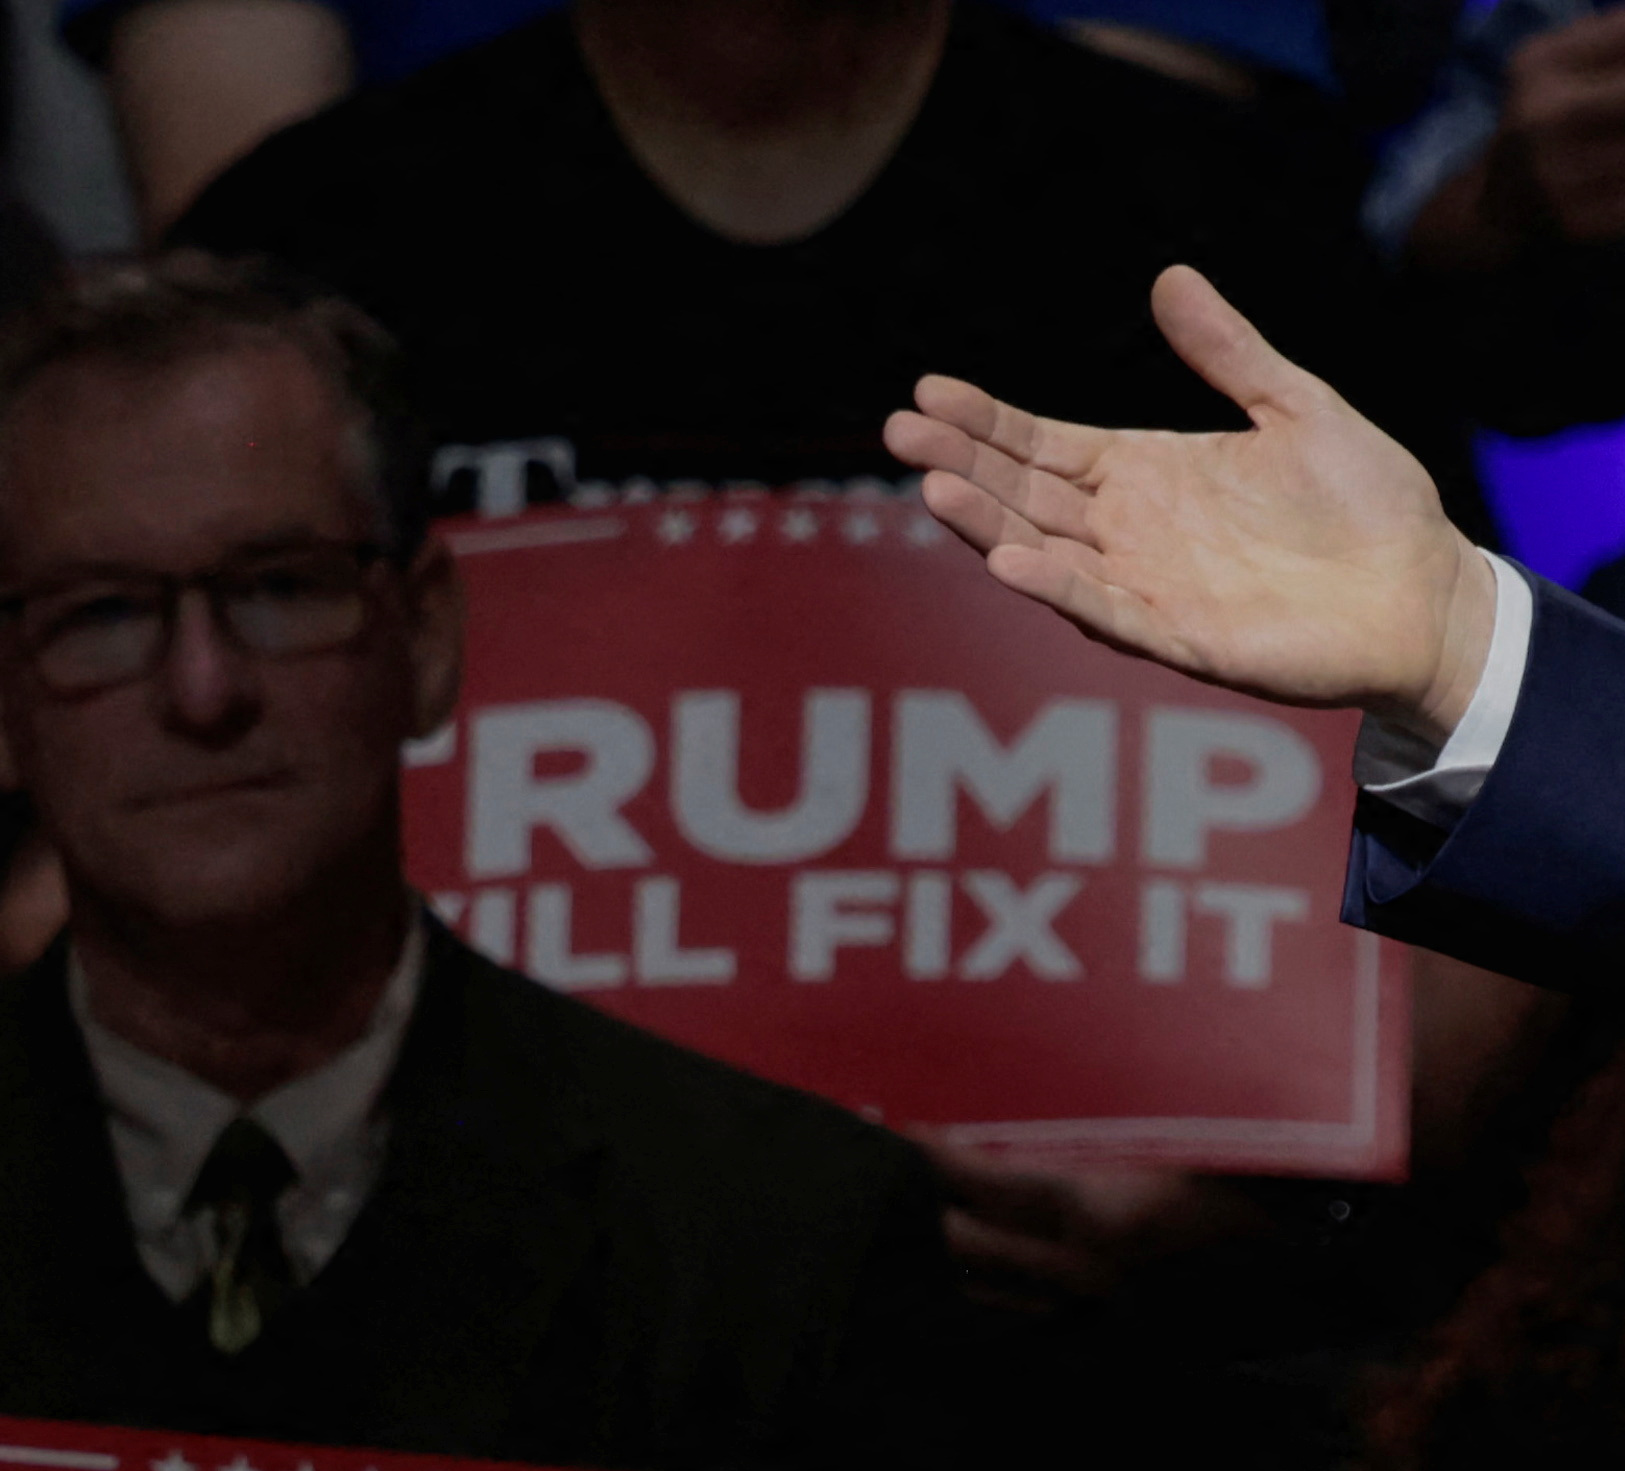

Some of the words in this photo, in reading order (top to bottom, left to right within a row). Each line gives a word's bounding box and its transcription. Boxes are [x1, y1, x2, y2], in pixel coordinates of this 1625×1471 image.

[403, 685, 1324, 880] RUMP
[430, 872, 740, 991] ILL
[785, 868, 1087, 985] FIX
[1136, 878, 1311, 990] IT
